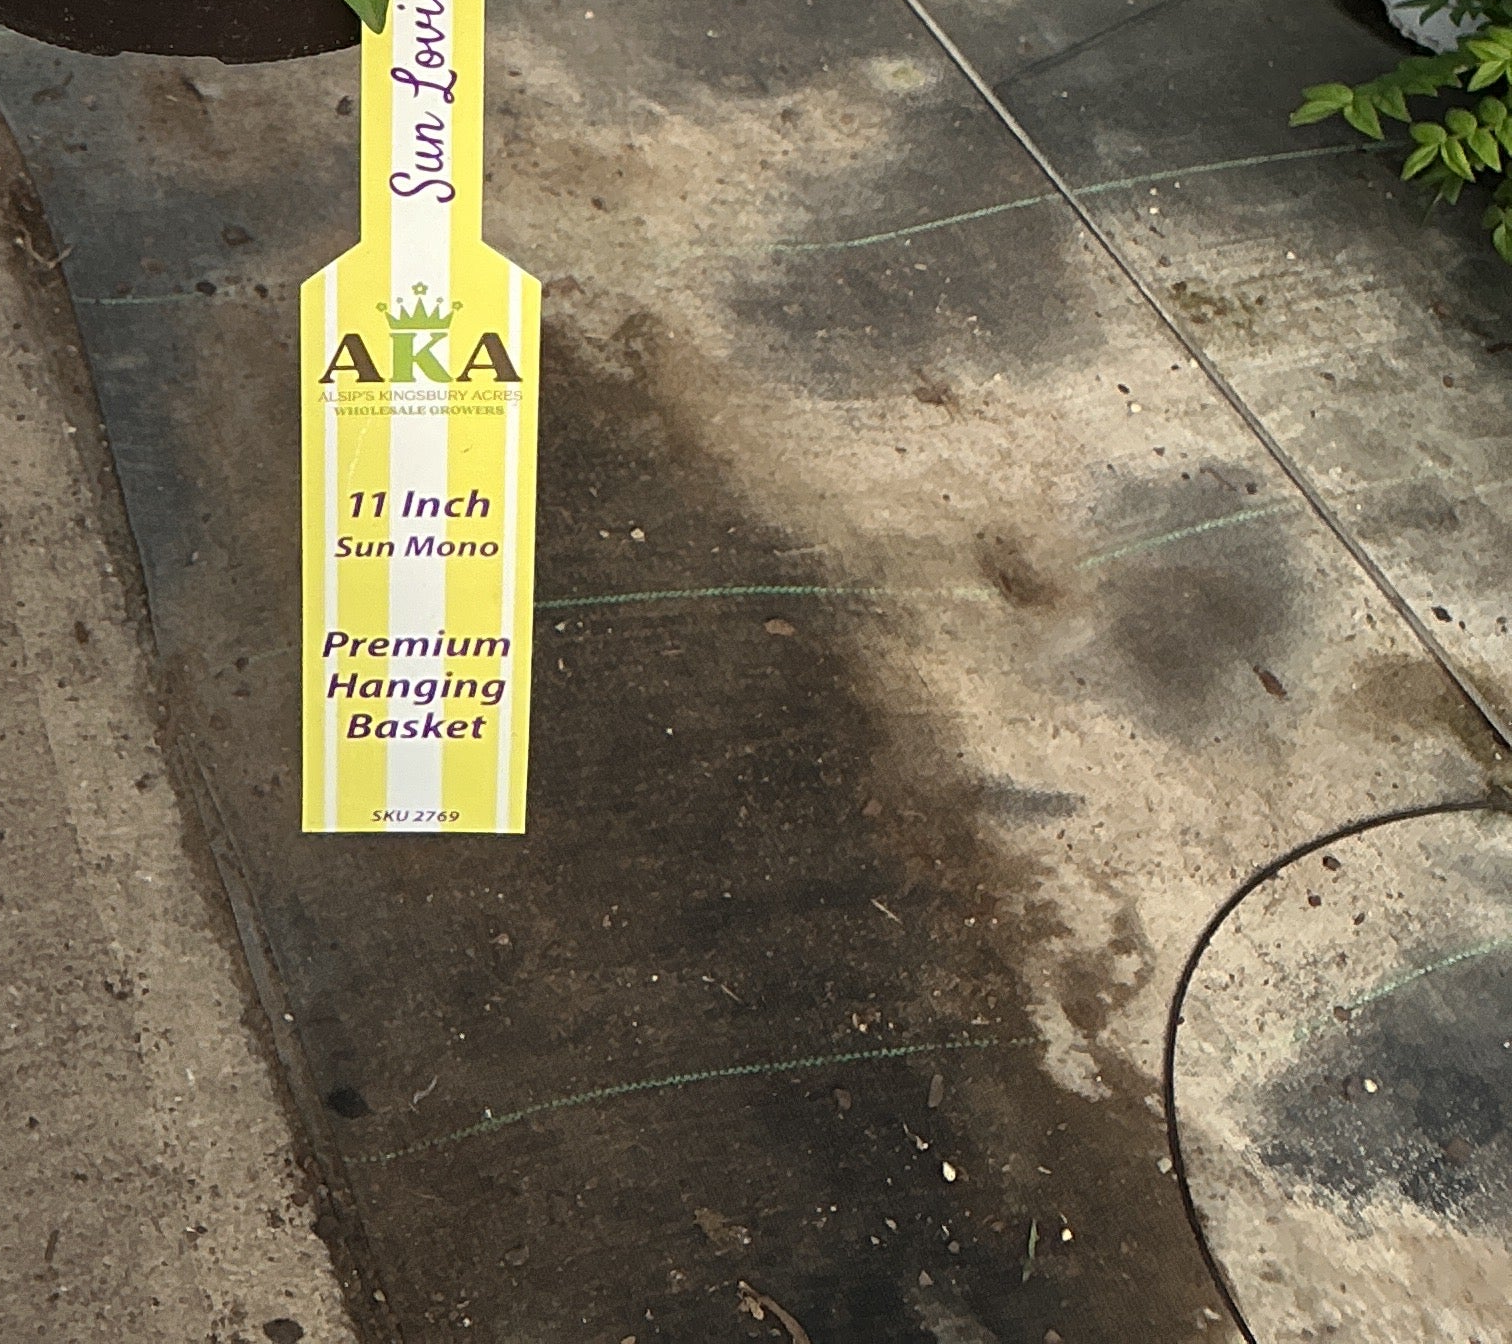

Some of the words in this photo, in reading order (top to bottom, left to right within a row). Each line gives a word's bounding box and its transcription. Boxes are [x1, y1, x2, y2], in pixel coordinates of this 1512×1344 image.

[389, 111, 456, 204] Sun
[318, 332, 524, 384] AKA
[318, 390, 375, 403] ALSIP'S
[379, 390, 470, 402] KINGSBURY
[472, 389, 524, 402] ACRES
[334, 405, 427, 417] WHOLESALE
[429, 405, 506, 416] GROWERS
[348, 490, 387, 518] 11
[401, 489, 491, 518] Inch
[334, 536, 395, 558] Sun
[404, 536, 499, 558] Mono
[322, 630, 511, 658] Premium
[326, 672, 506, 706] Hanging
[346, 713, 487, 740] Basket
[371, 810, 409, 823] SKU
[411, 810, 460, 823] 2769
